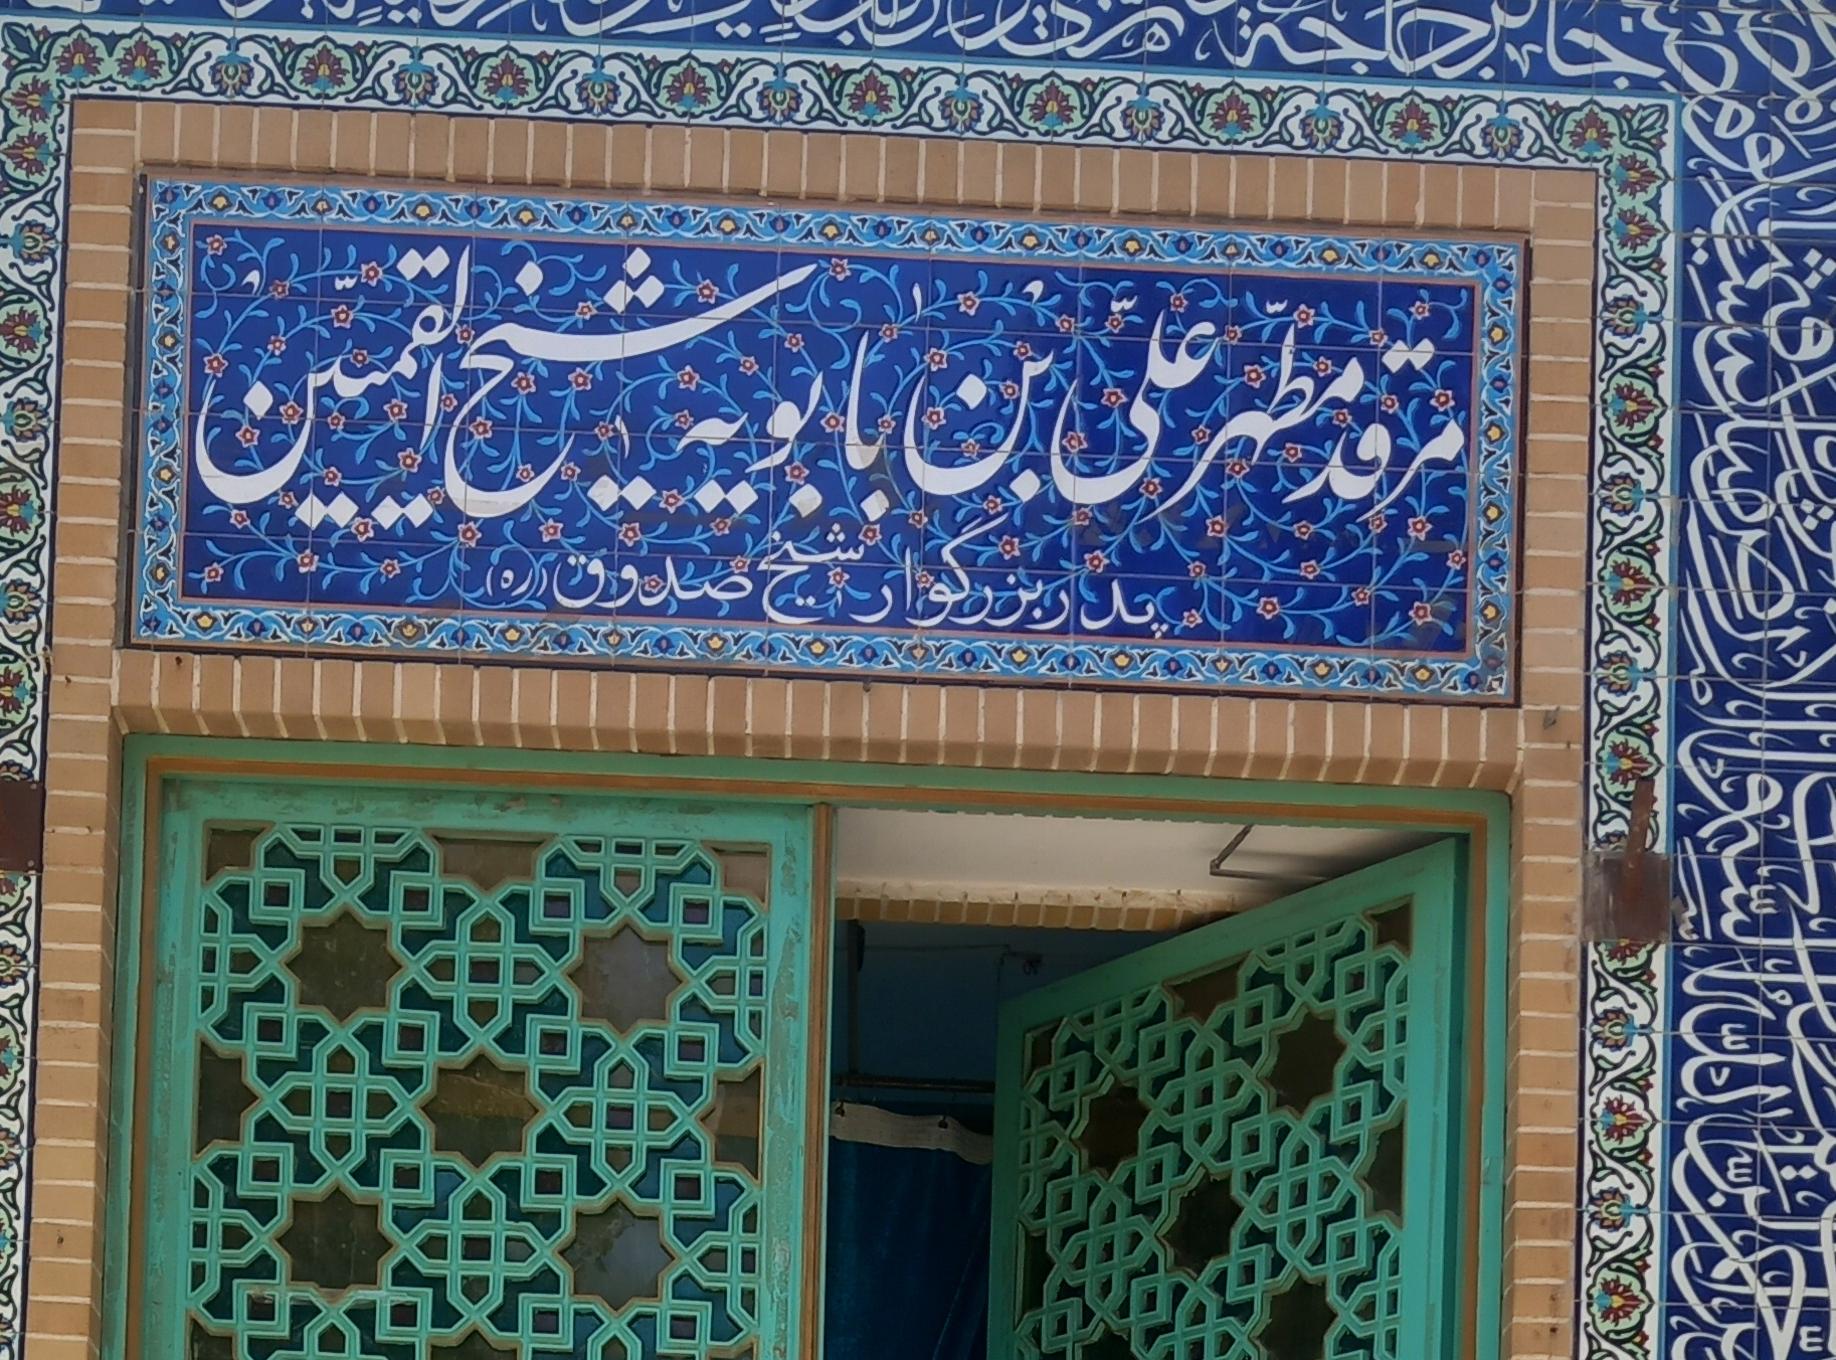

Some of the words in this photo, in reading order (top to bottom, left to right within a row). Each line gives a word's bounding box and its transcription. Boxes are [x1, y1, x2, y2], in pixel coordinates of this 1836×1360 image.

[443, 246, 819, 518] شیخ
[1281, 338, 1465, 523] مرقد
[552, 553, 754, 609] صدوق
[756, 522, 865, 625] شیخ
[848, 511, 1043, 630] بزرگوار
[1024, 578, 1169, 639] پدر
